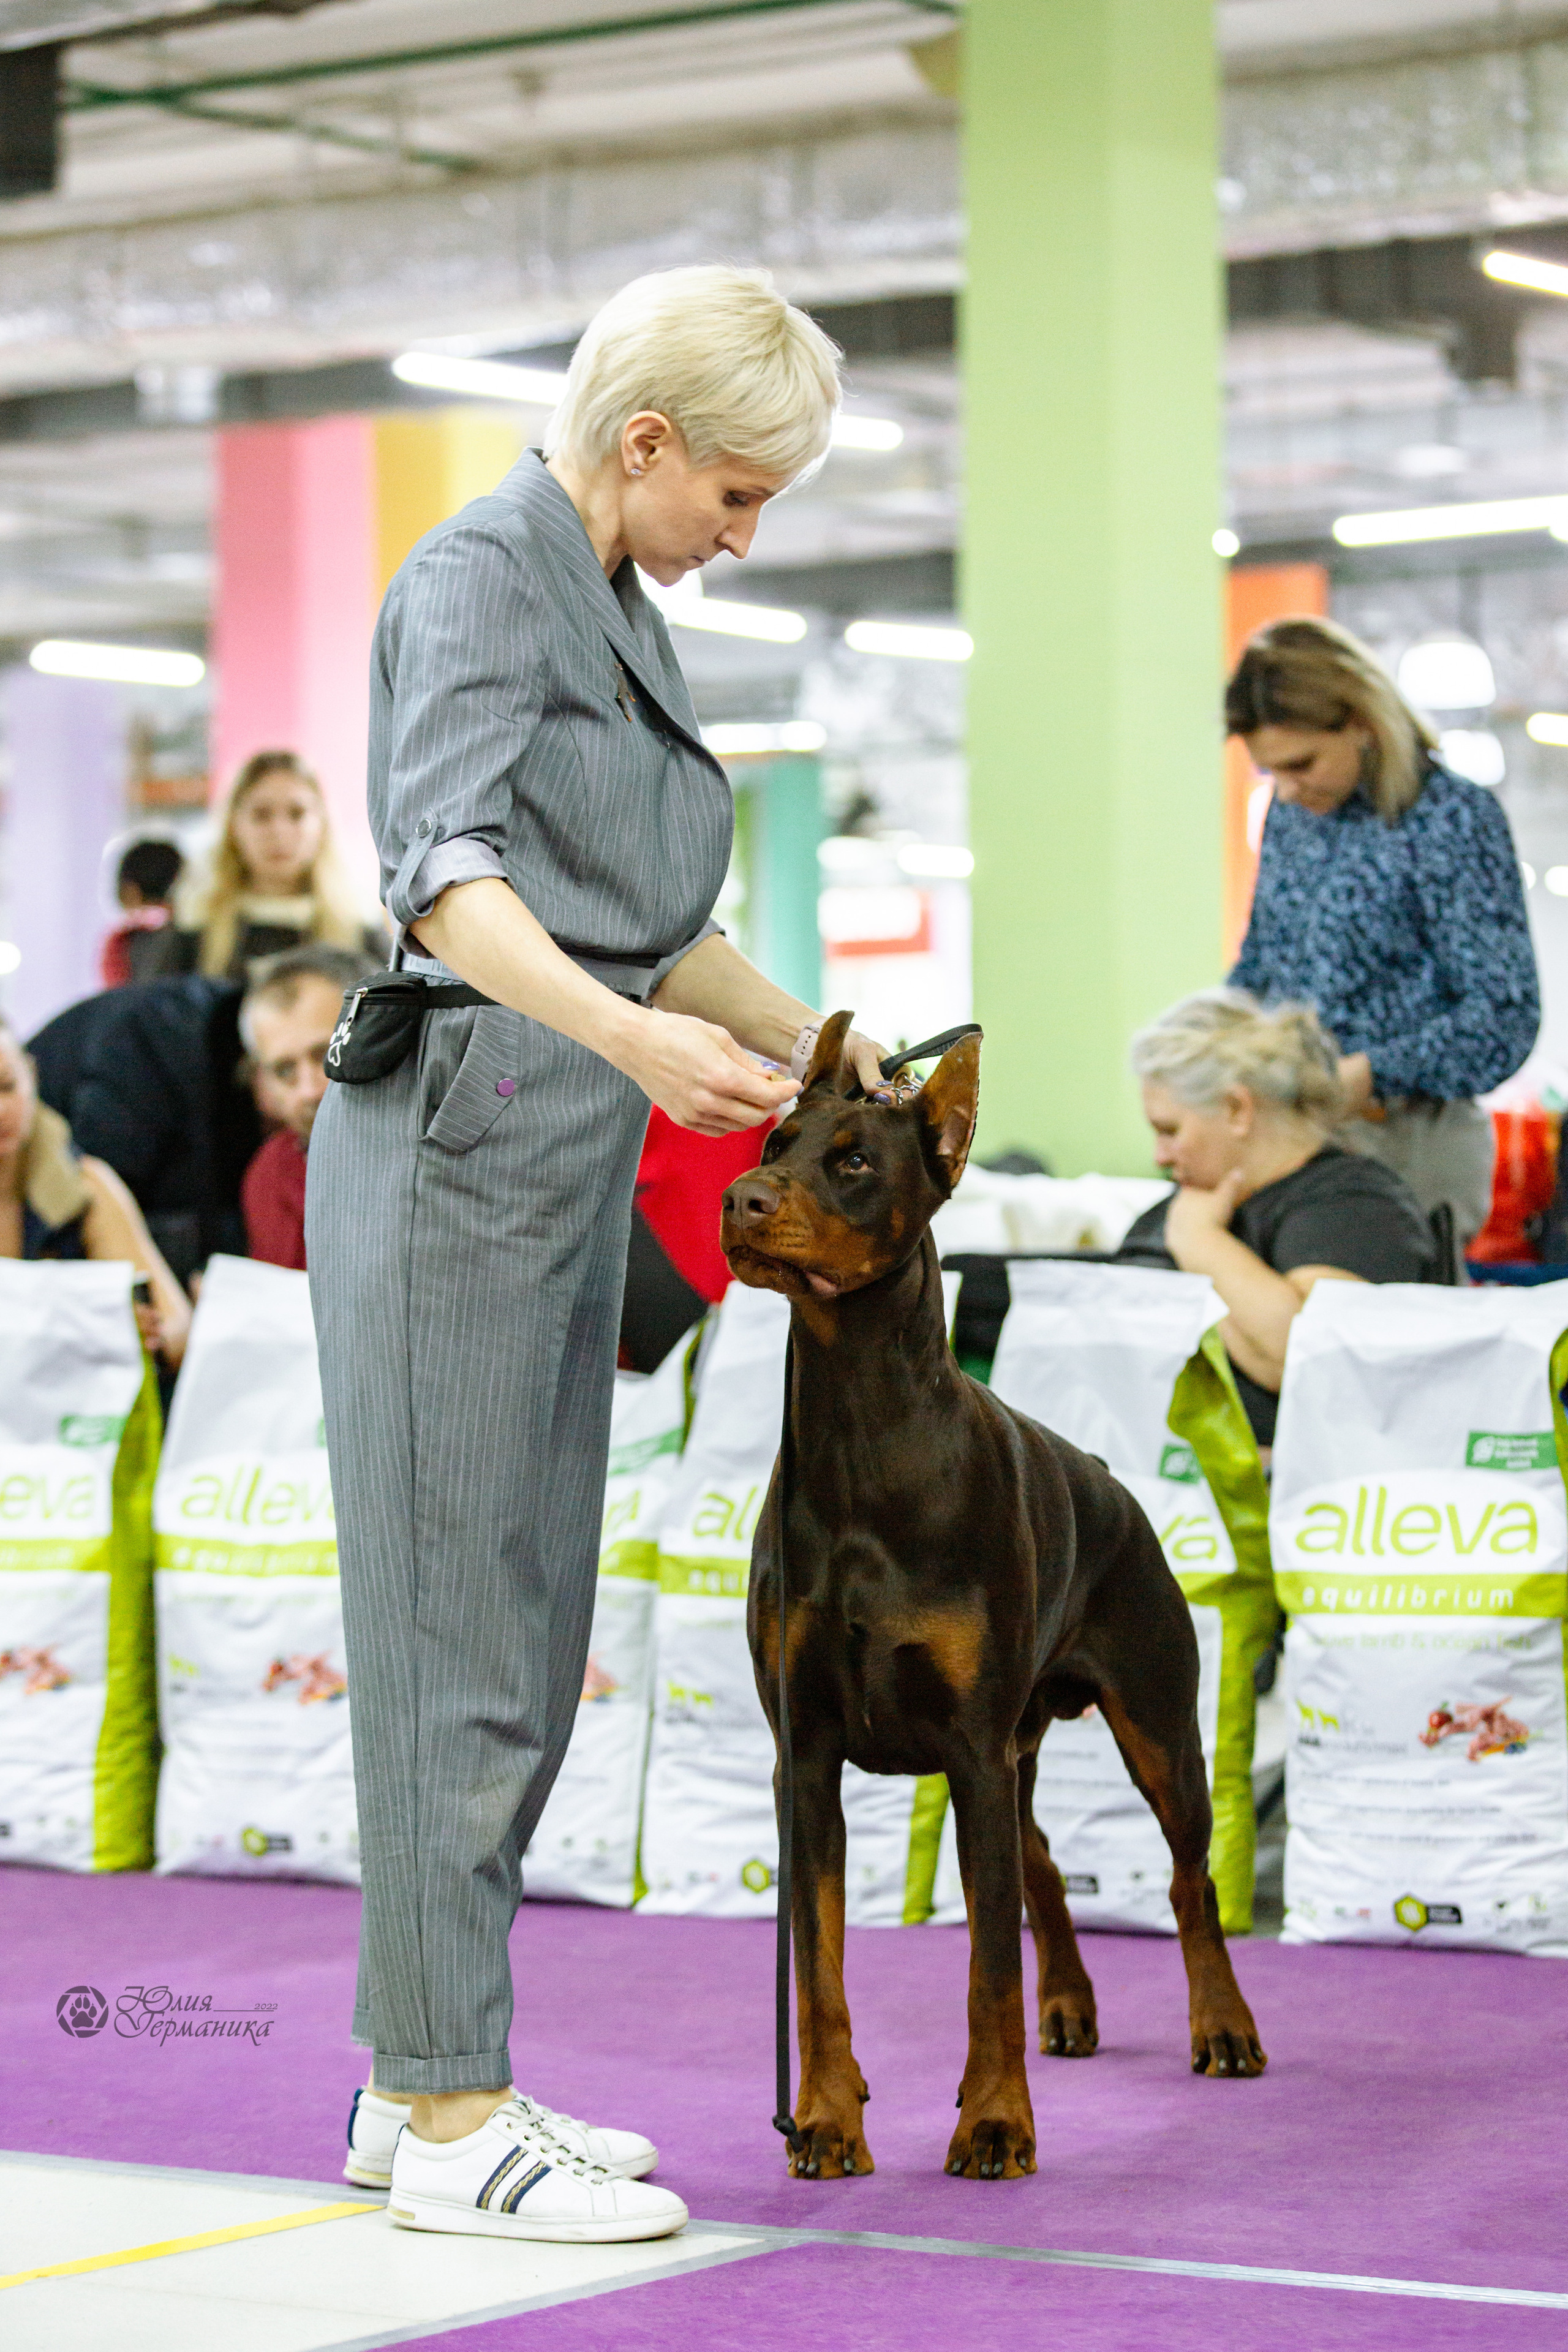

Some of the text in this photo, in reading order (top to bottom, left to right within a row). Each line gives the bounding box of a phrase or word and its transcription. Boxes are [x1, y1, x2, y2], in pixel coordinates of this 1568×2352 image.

[181, 1464, 336, 1525] allev
[1295, 1485, 1538, 1556] alleva
[1303, 1584, 1514, 1612] equilibrium
